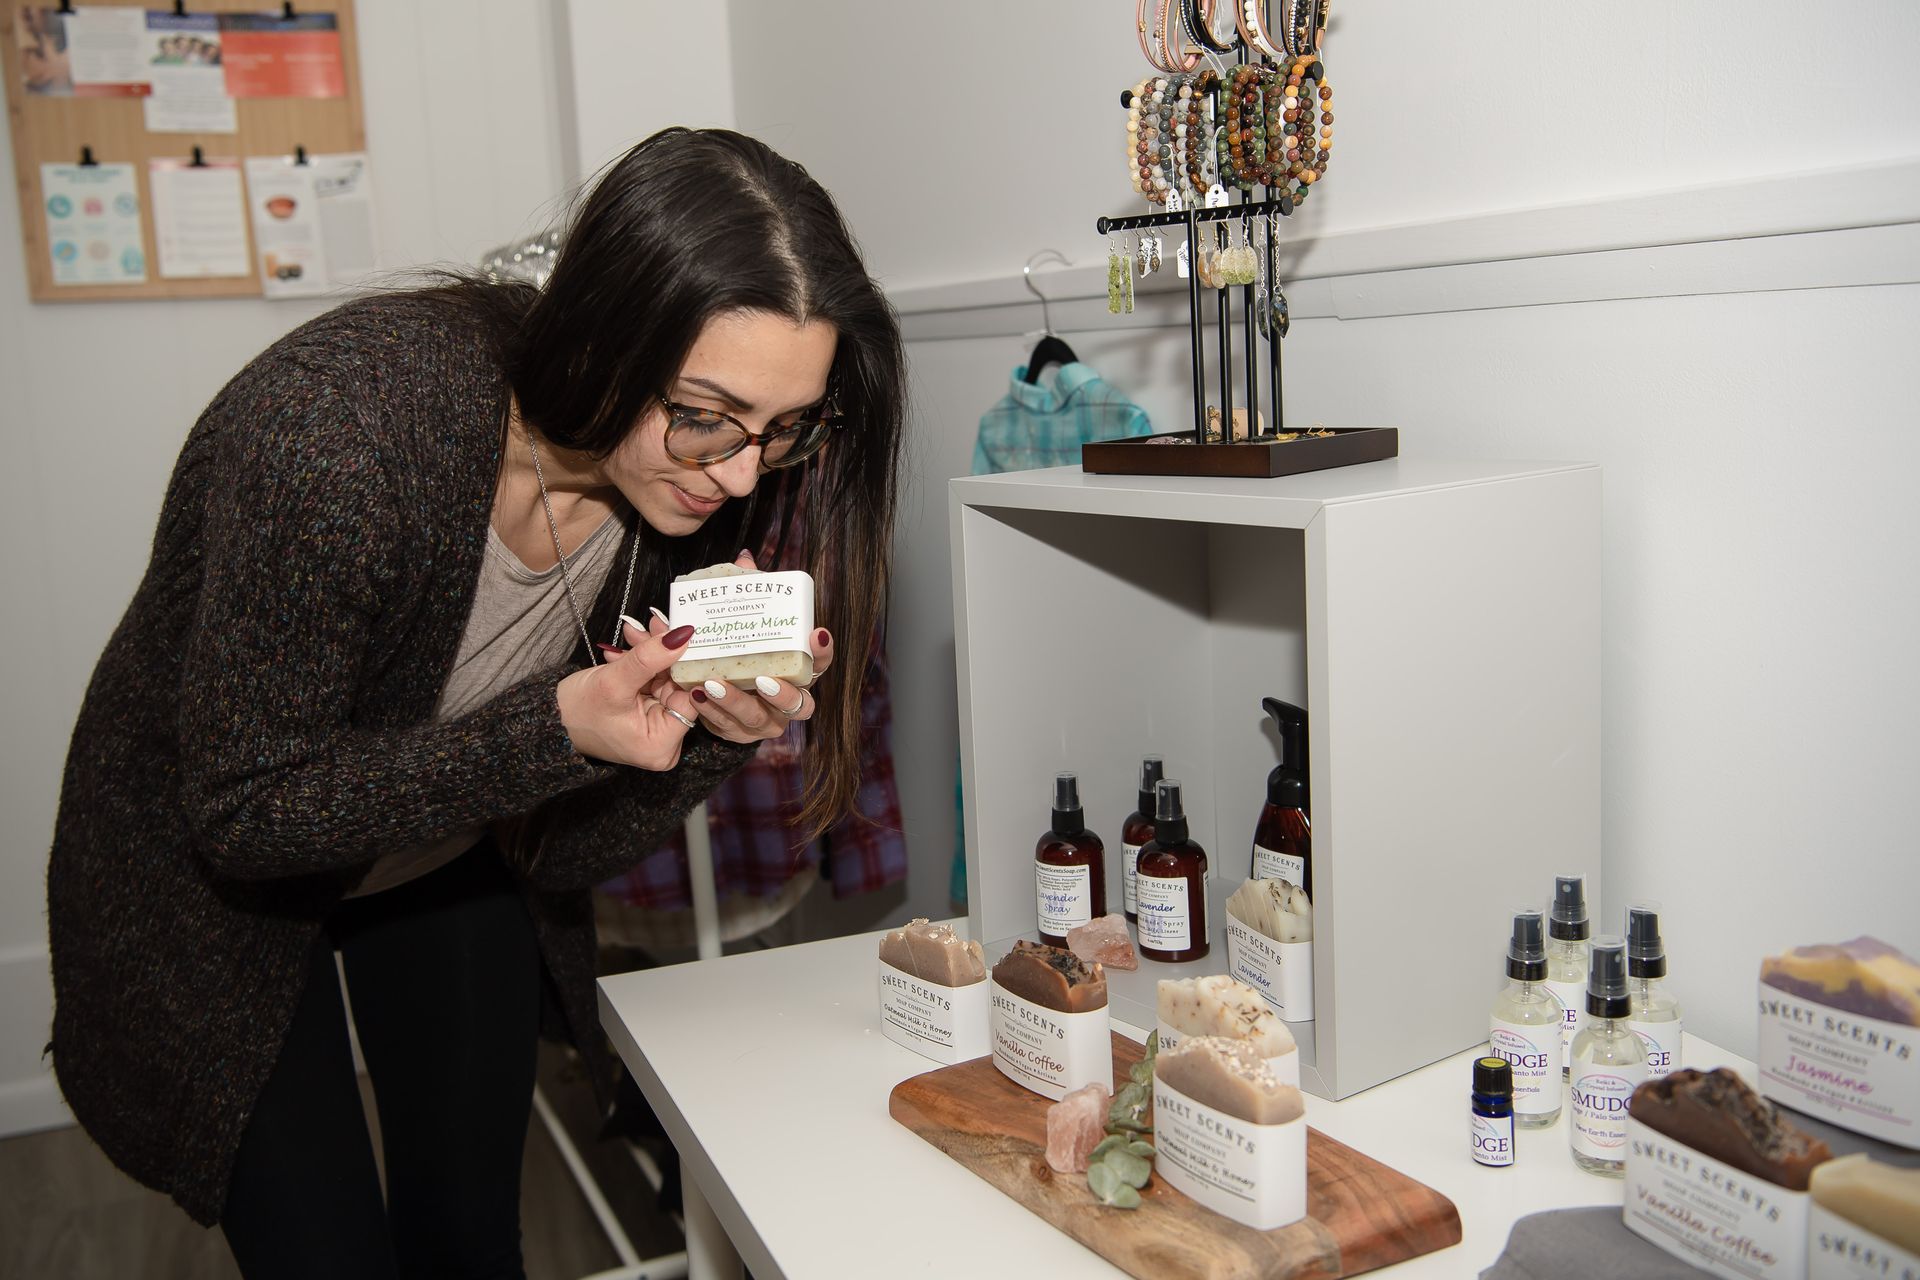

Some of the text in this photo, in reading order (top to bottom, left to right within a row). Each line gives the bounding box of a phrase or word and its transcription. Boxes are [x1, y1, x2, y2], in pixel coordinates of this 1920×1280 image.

[678, 583, 794, 606] SWEET SCENTS
[705, 603, 767, 615] SOAP COMPANY
[694, 616, 799, 636] calyptus Mint
[1272, 856, 1301, 871] SCENTS
[1151, 882, 1184, 892] SCENTS
[1228, 924, 1282, 965] SWEET SCENTS
[1238, 960, 1271, 988] Lavender
[882, 975, 951, 1011] SWEET SCENTS
[908, 1003, 932, 1017] COMPANY
[884, 1003, 907, 1020] Oatmeal
[930, 1023, 952, 1038] Honey
[993, 995, 1065, 1040] SWEET SCENTS
[1760, 1000, 1912, 1060] SWEET SCENTS
[995, 1029, 1064, 1073] Vanilla Coffee
[1016, 1029, 1042, 1045] COMPANY
[1784, 1055, 1874, 1095] Jasmine
[1156, 1094, 1256, 1154] SWEET SCENTS
[1591, 1111, 1607, 1120] Palo
[1609, 1113, 1626, 1121] Sant
[1632, 1140, 1781, 1223] SWEET SCENTS
[1711, 1225, 1778, 1266] Coffee
